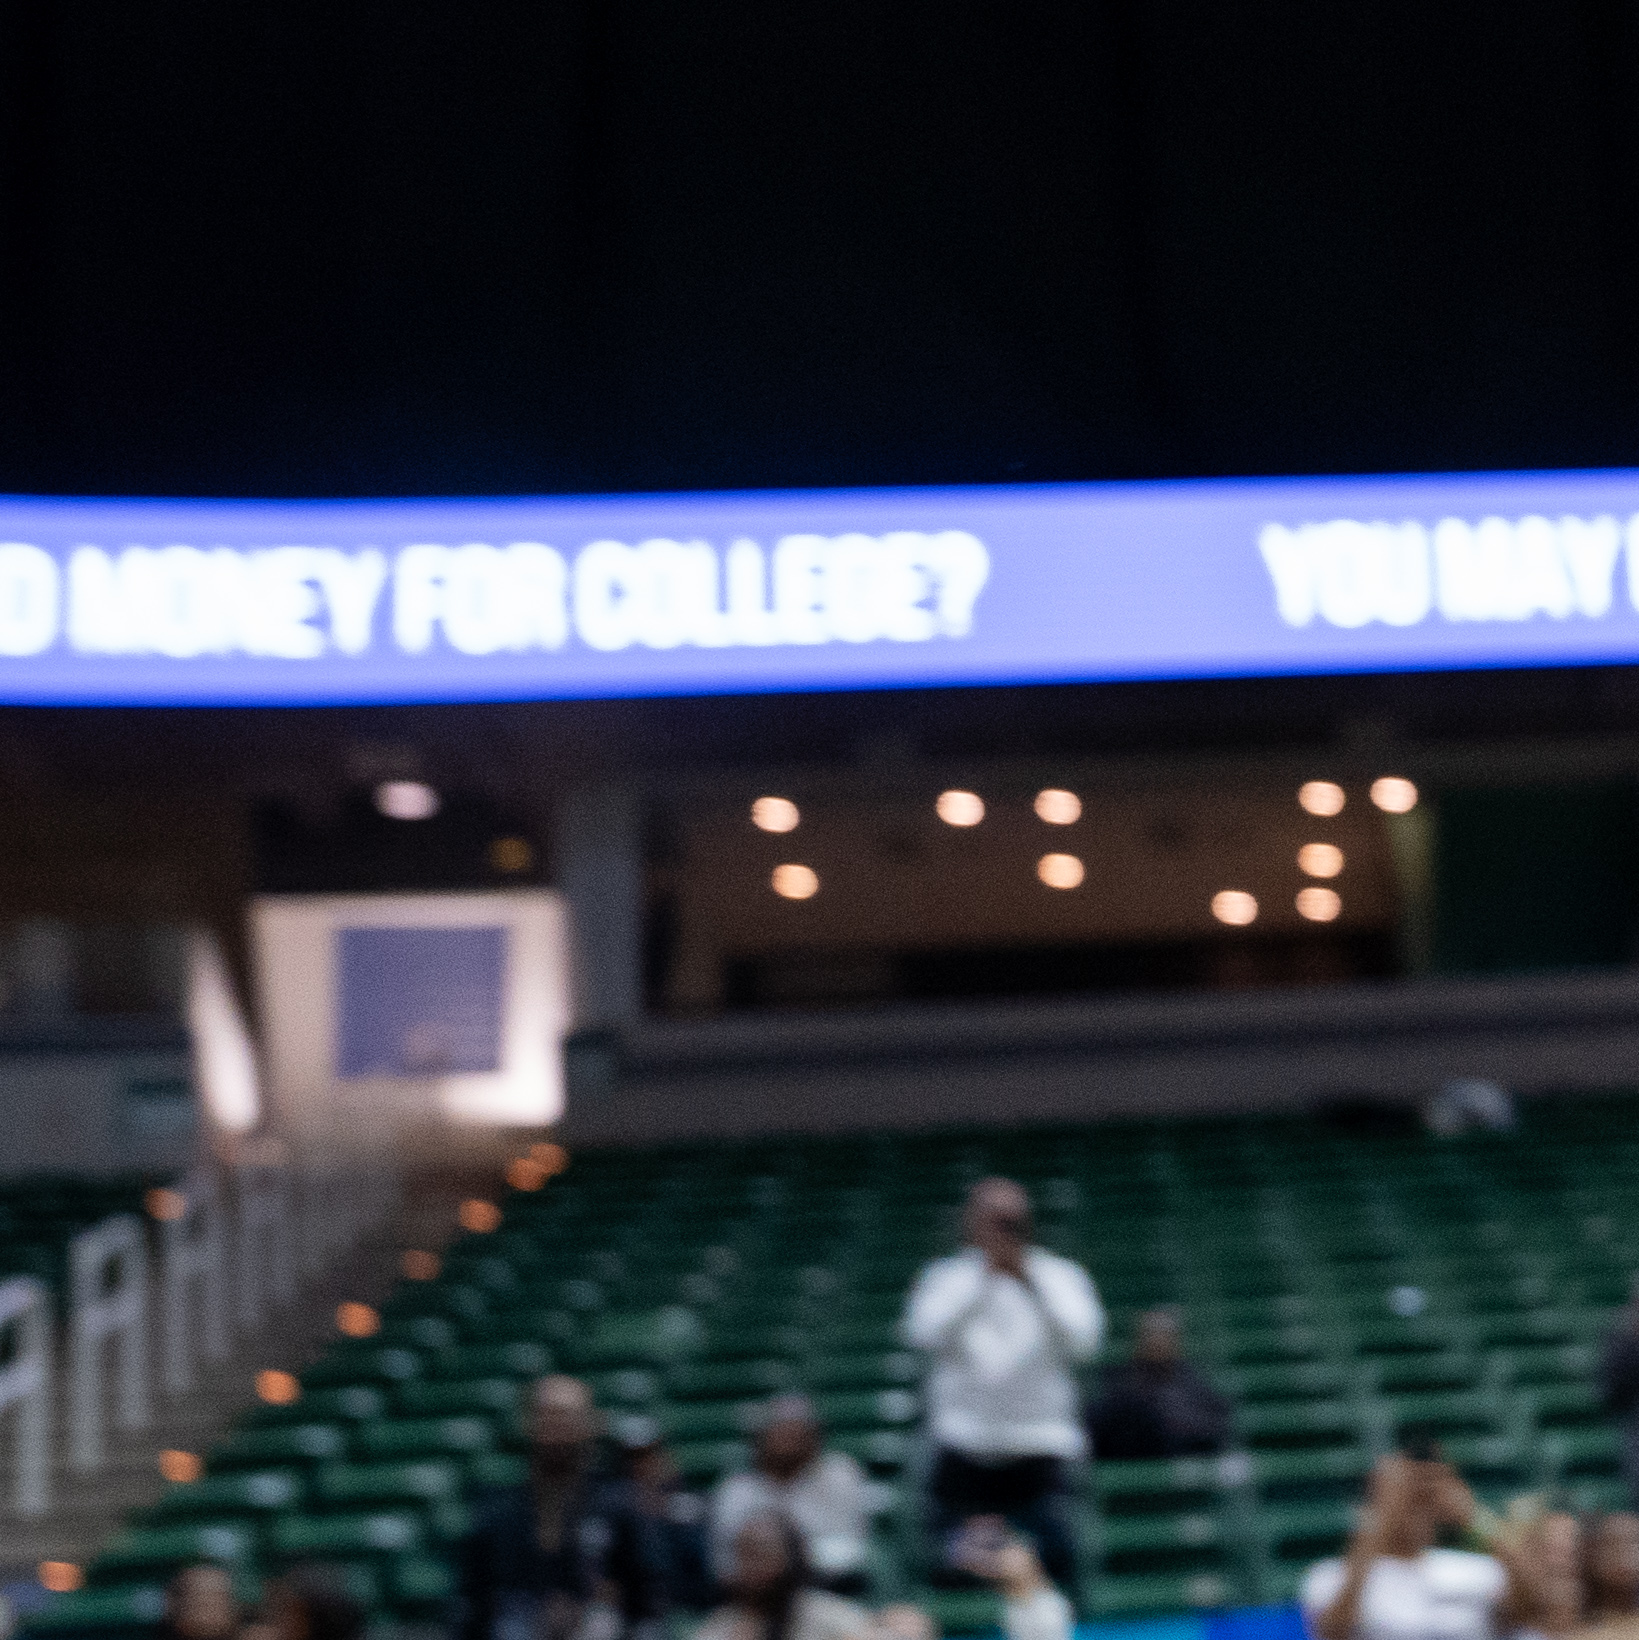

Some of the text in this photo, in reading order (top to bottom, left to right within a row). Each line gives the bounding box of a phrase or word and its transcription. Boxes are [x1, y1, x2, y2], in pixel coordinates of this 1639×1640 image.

[67, 545, 386, 659] MONEY
[393, 541, 570, 656] FOR
[573, 529, 990, 651] COLLEGE?
[1258, 518, 1429, 628] YOU
[1432, 514, 1621, 621] MAY
